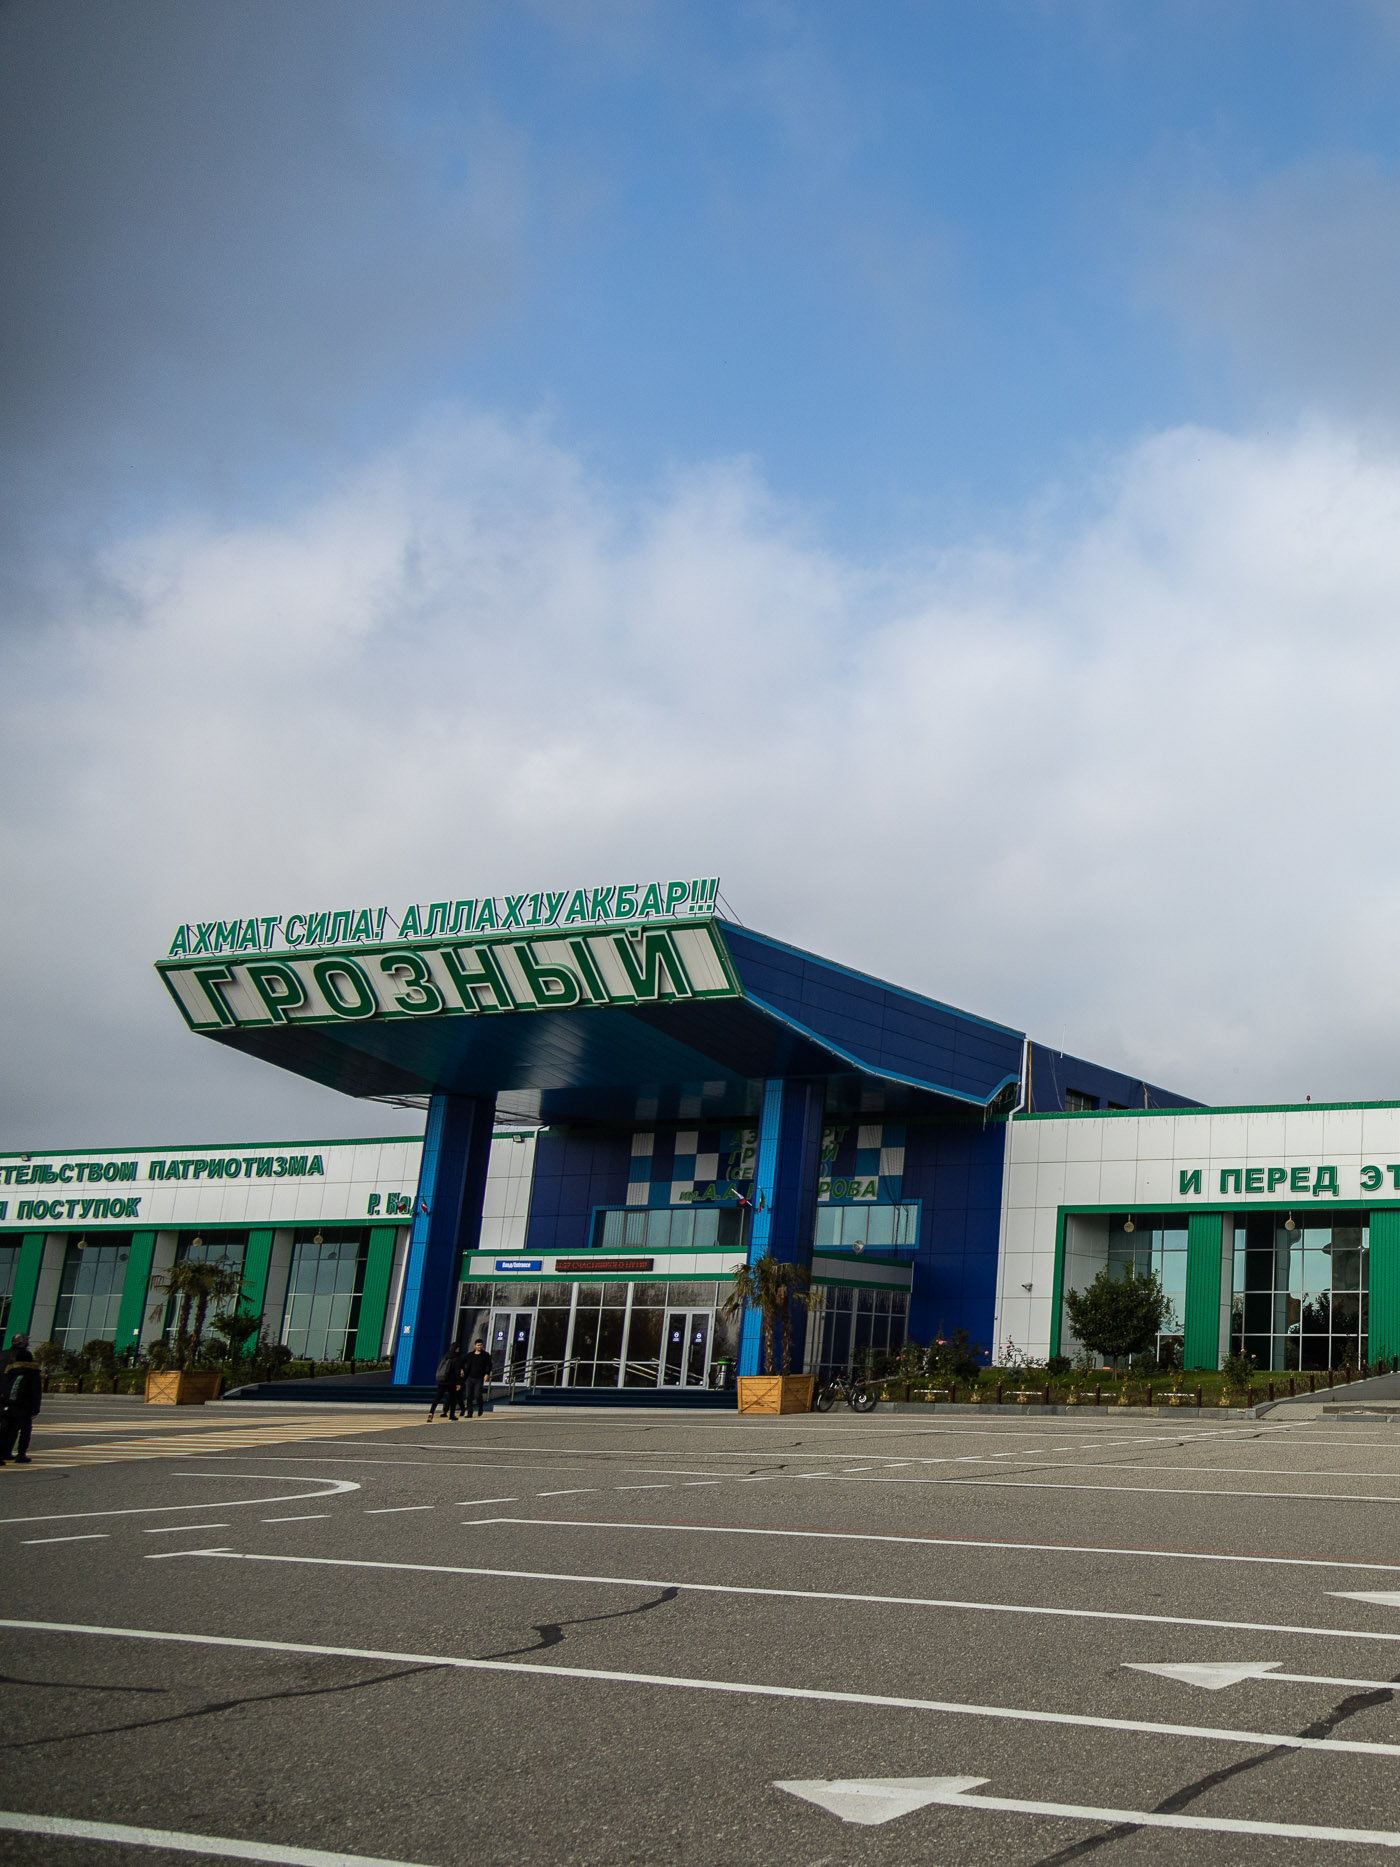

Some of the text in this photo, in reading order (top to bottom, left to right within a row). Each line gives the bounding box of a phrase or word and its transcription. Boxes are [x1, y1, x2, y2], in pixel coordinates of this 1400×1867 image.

[168, 914, 281, 957] АХМАТ
[283, 905, 386, 946] СИЛА!
[194, 926, 694, 1029] ГРОЗНЫЙ
[0, 1154, 324, 1185] ТЕЛЬСТВОМ ПАТРИОТИЗМА
[1179, 1169, 1202, 1195] И
[1219, 1165, 1339, 1197] ПЕРЕД
[17, 1197, 142, 1221] ПОСТУПОК
[367, 1193, 381, 1215] Р.
